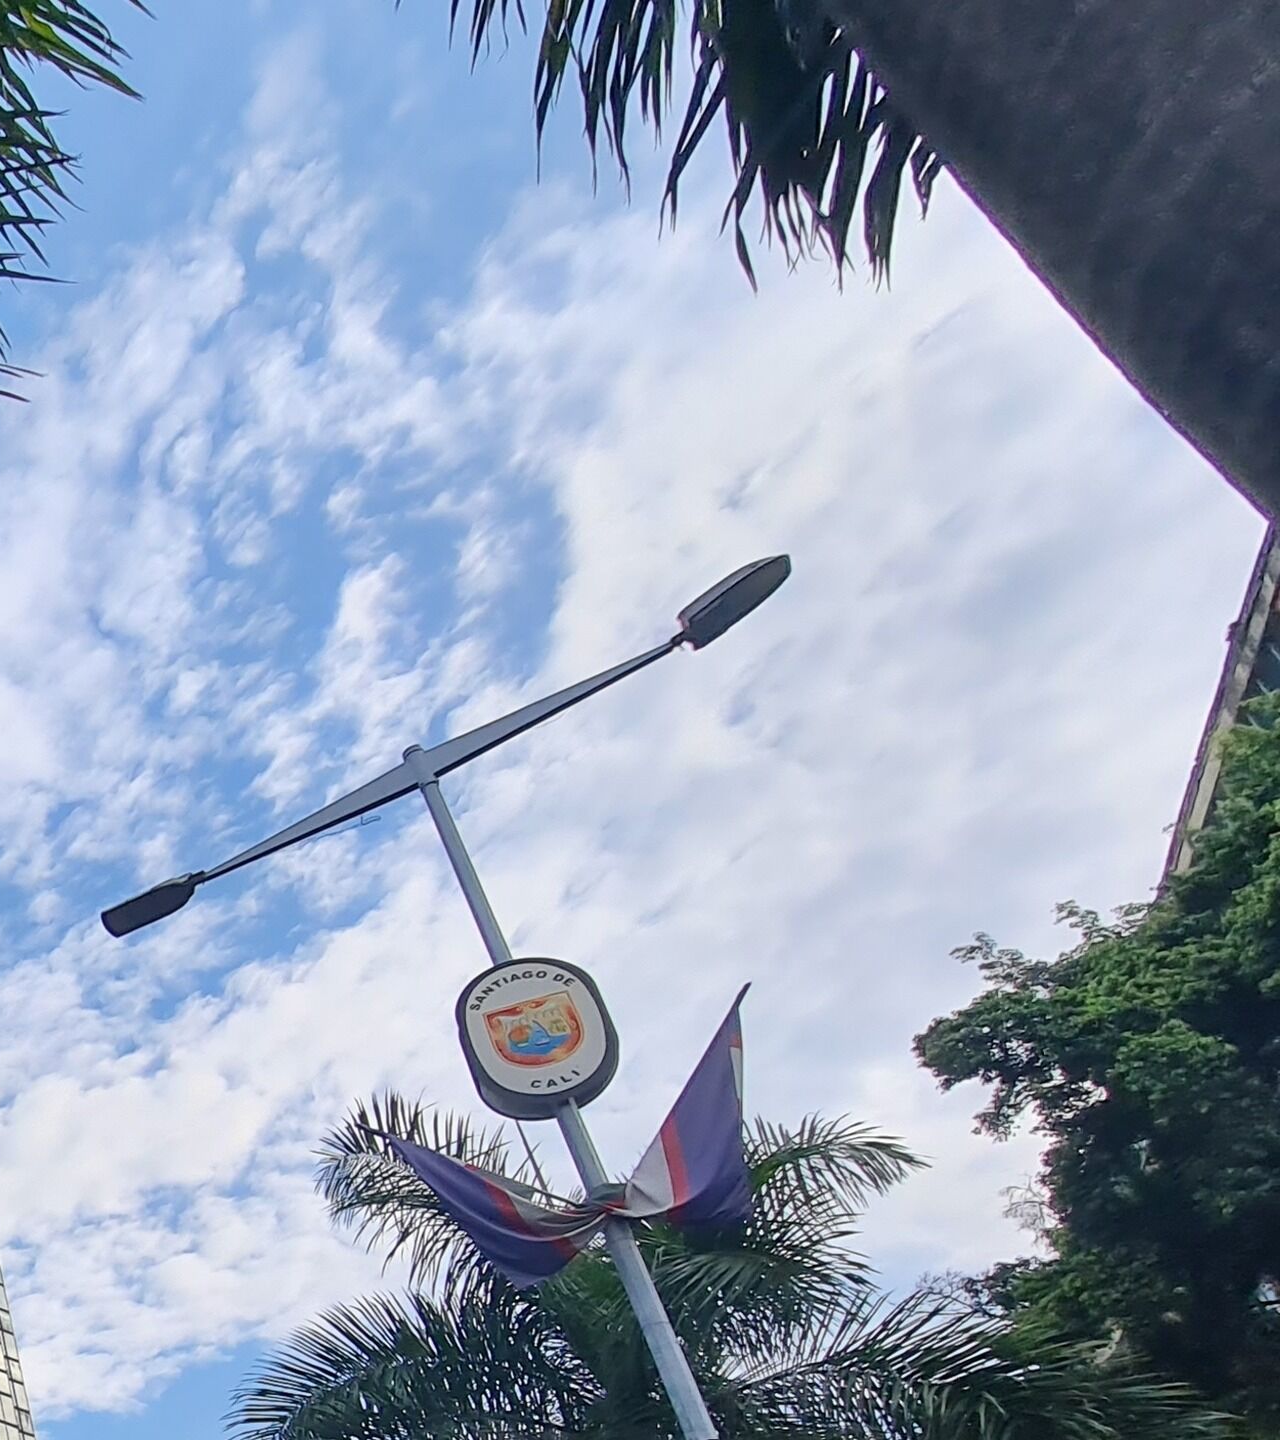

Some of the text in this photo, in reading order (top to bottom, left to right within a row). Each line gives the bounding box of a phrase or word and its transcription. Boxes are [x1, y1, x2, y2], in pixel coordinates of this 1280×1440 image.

[470, 971, 575, 1011] SANTIAGO DE
[531, 1070, 580, 1088] CALI
